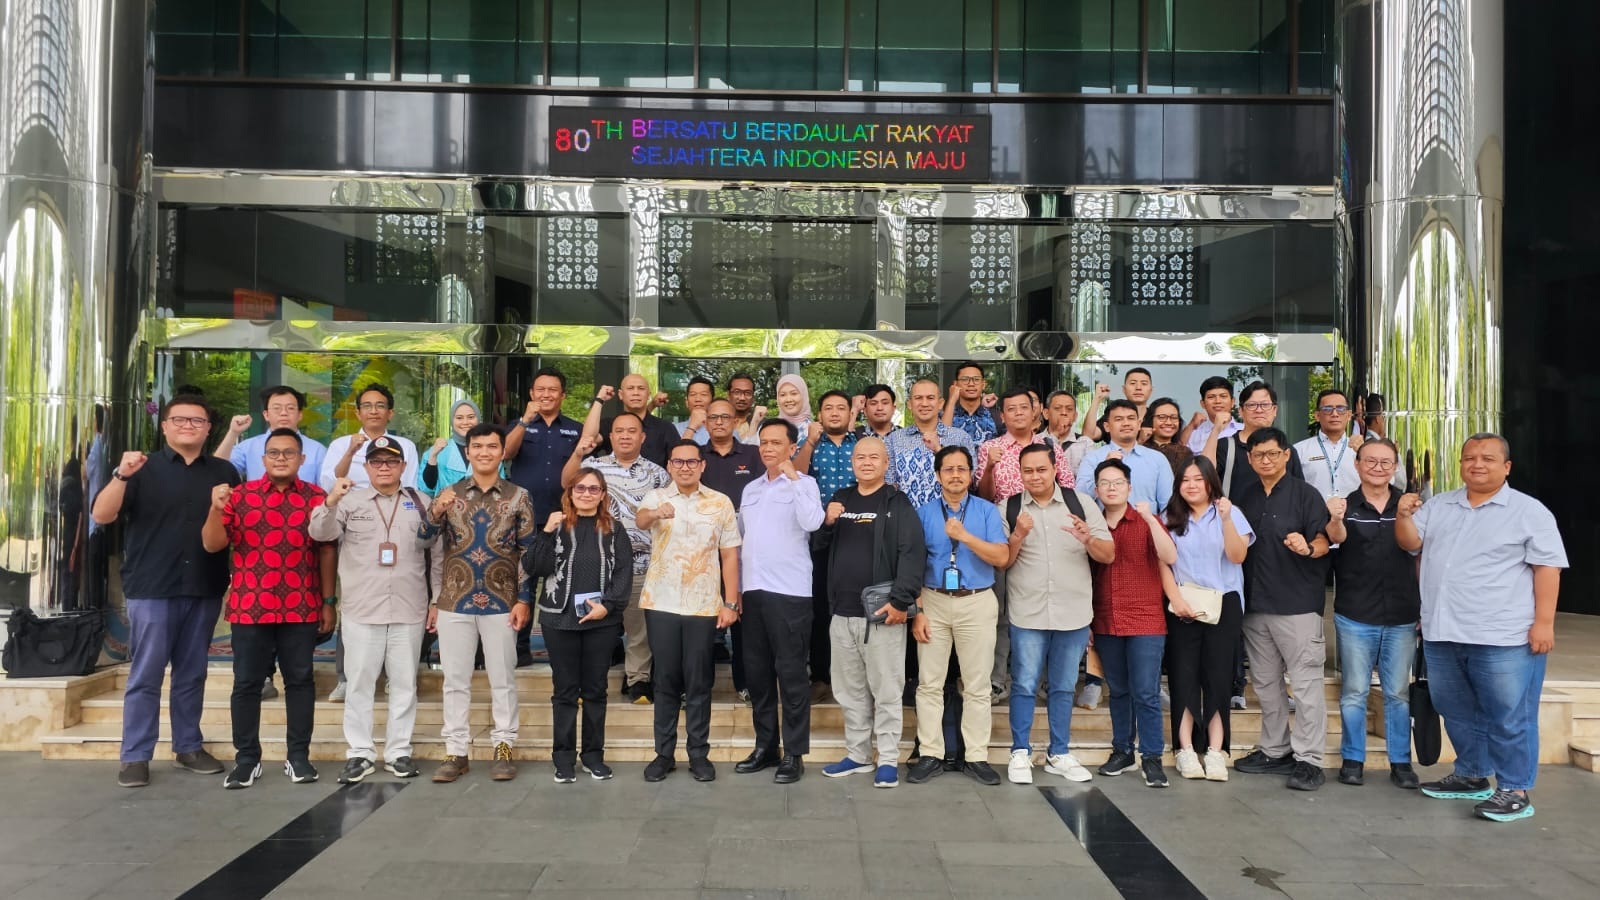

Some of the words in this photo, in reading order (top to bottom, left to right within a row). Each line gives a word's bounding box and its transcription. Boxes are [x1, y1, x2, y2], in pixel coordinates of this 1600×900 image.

[631, 118, 738, 141] BERSATU
[745, 121, 880, 143] BERDAULAT
[886, 123, 975, 144] RAKYAT
[631, 145, 767, 168] SEJAHTERA
[773, 148, 900, 169] INDONESIA
[905, 150, 967, 170] MAJU
